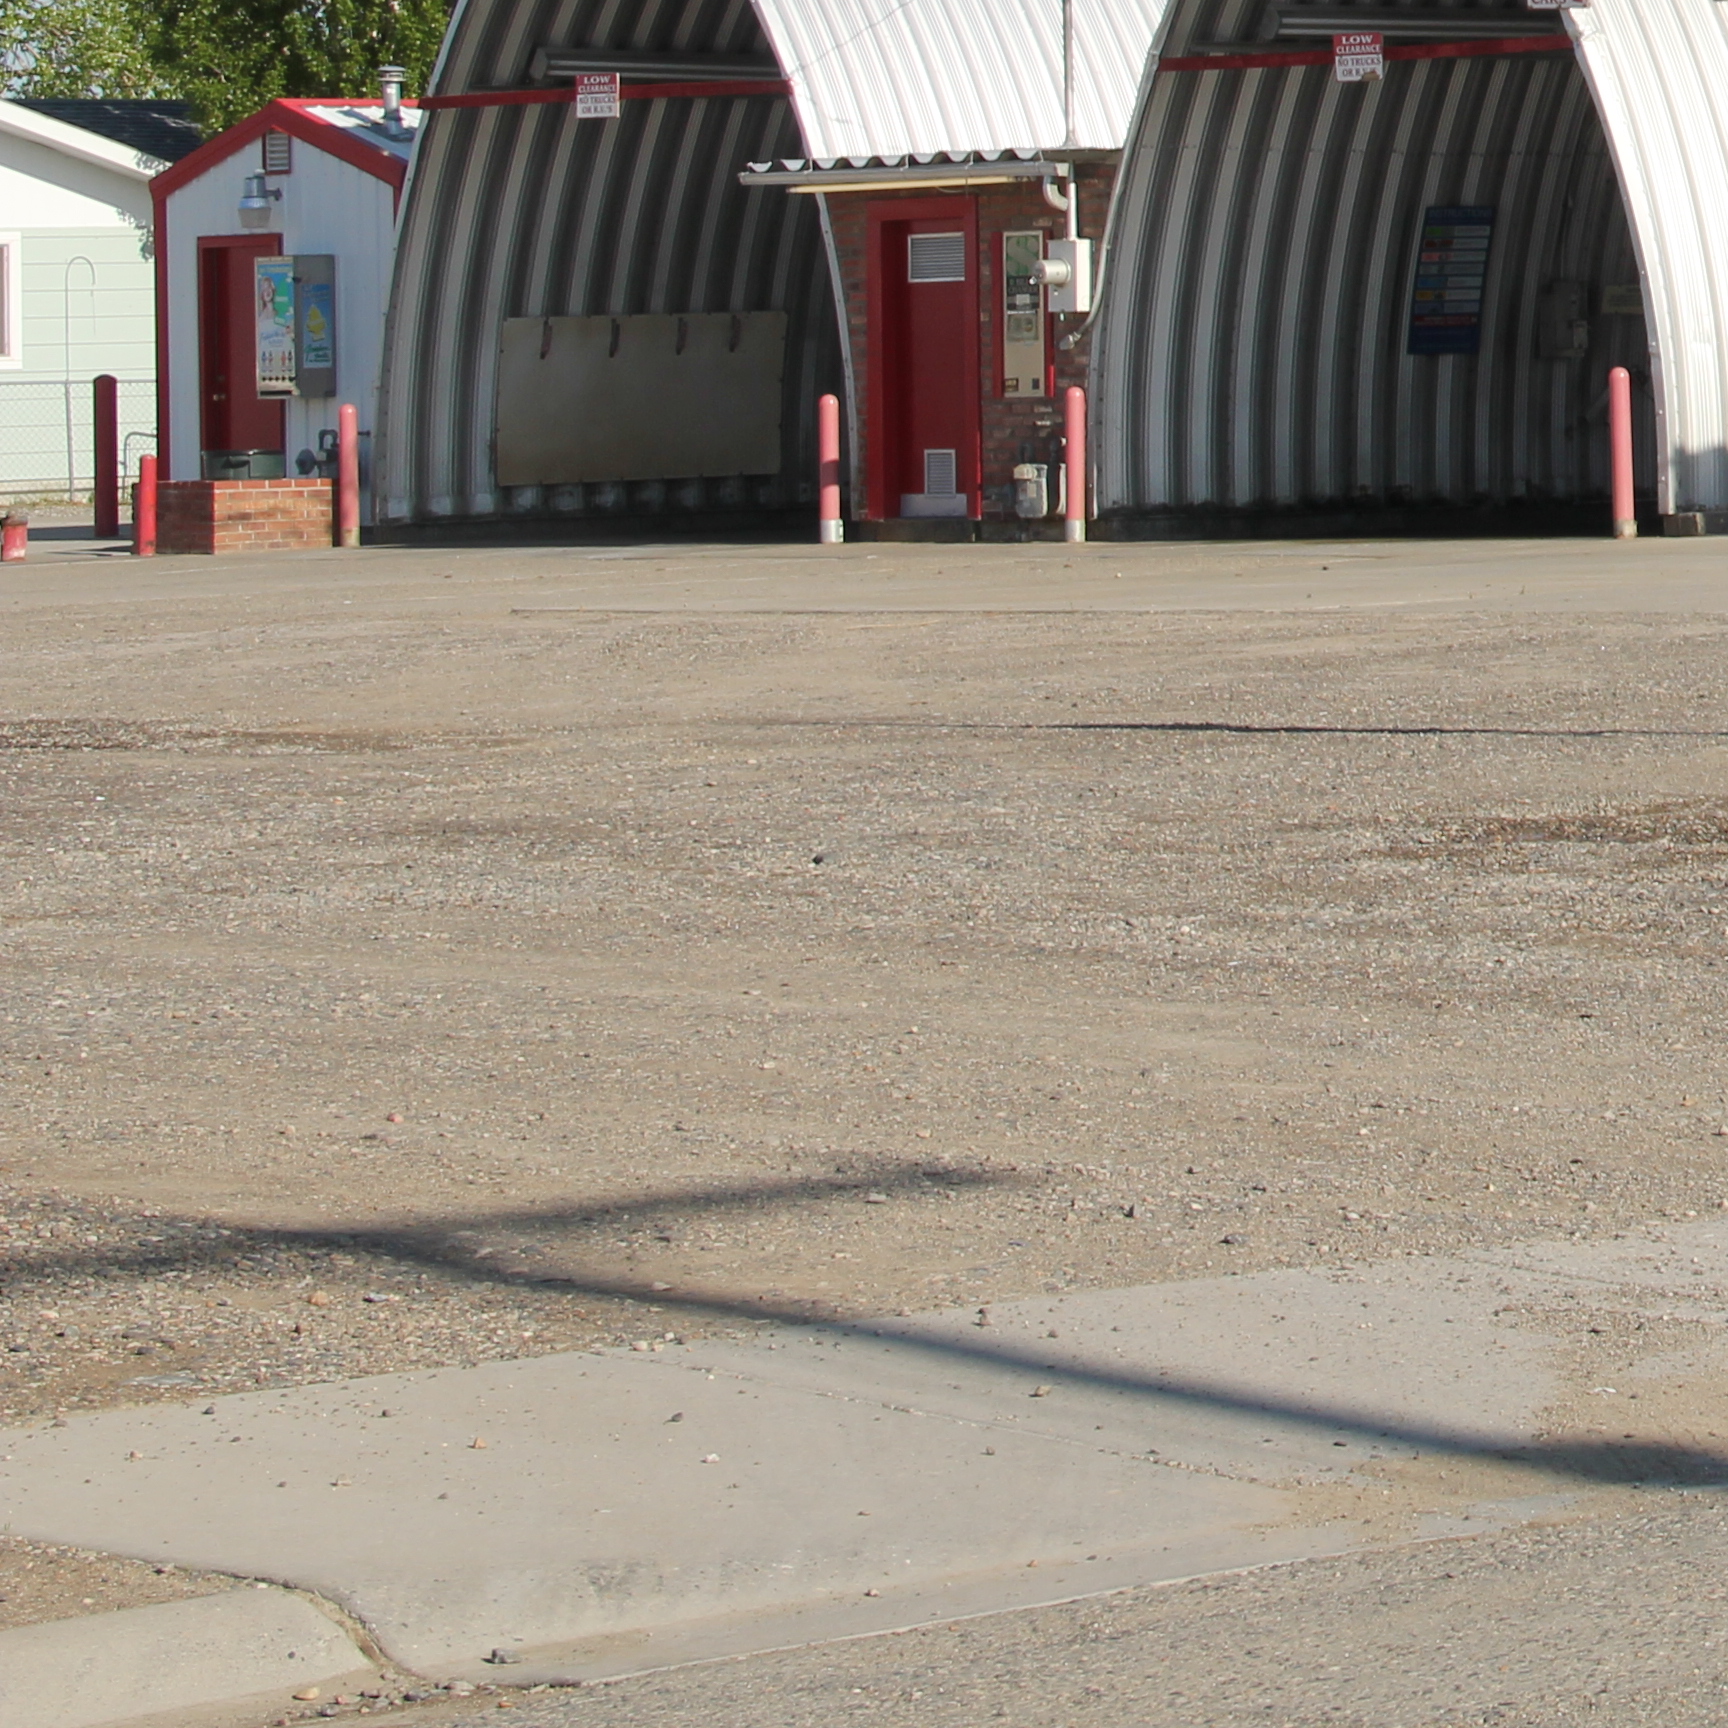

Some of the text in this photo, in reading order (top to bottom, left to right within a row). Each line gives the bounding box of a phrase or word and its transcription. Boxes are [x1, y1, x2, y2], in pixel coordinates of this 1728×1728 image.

[1342, 35, 1373, 44] LOW
[1336, 44, 1380, 54] CLEARANCE
[584, 75, 611, 84] LOW
